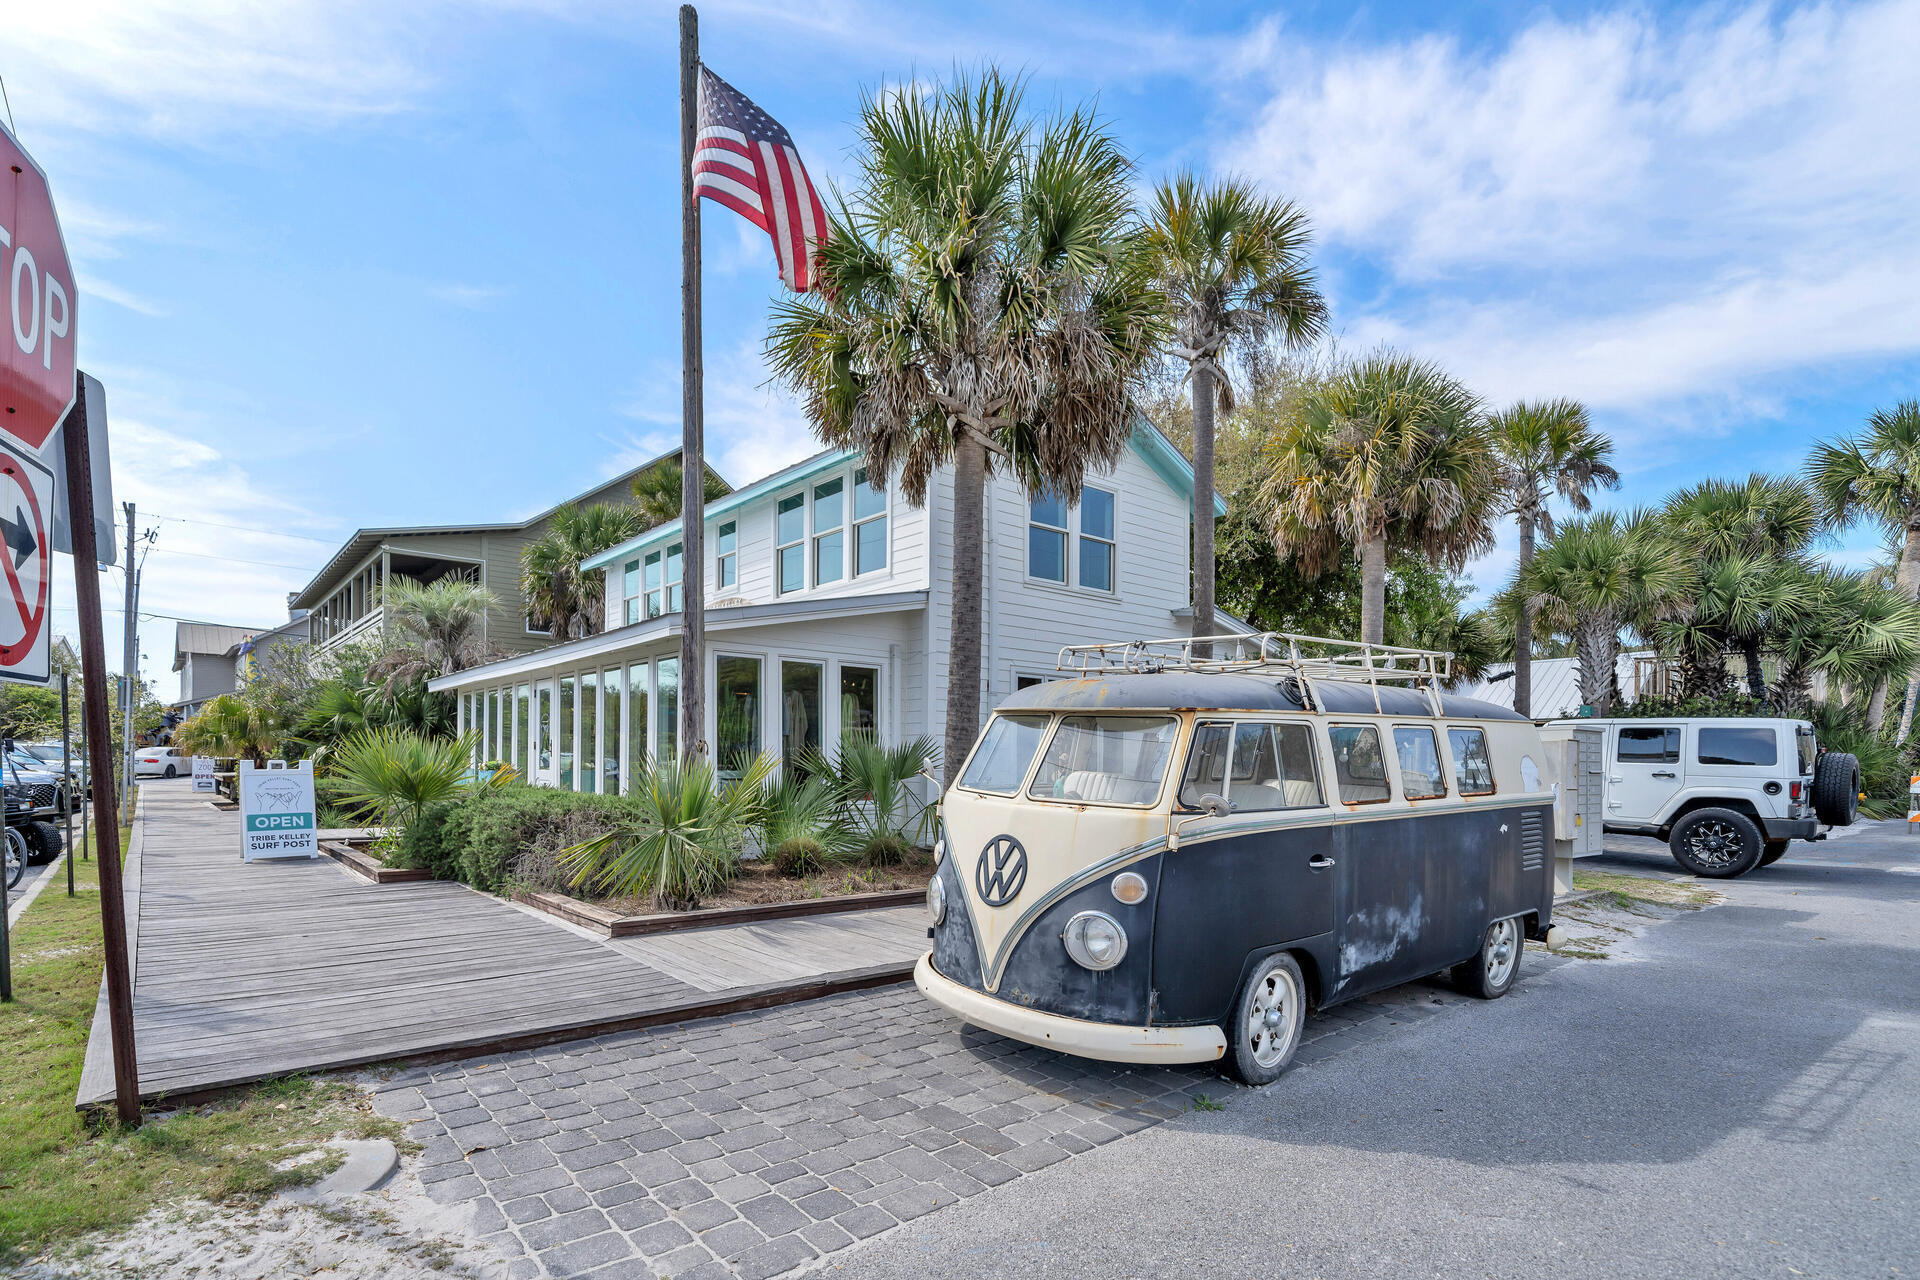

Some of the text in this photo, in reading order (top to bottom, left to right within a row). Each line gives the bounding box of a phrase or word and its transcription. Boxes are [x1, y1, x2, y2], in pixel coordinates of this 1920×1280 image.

[255, 815, 305, 829] OPEN
[250, 832, 311, 842] TRIBE KELLEY
[250, 840, 311, 850] SURF POST
